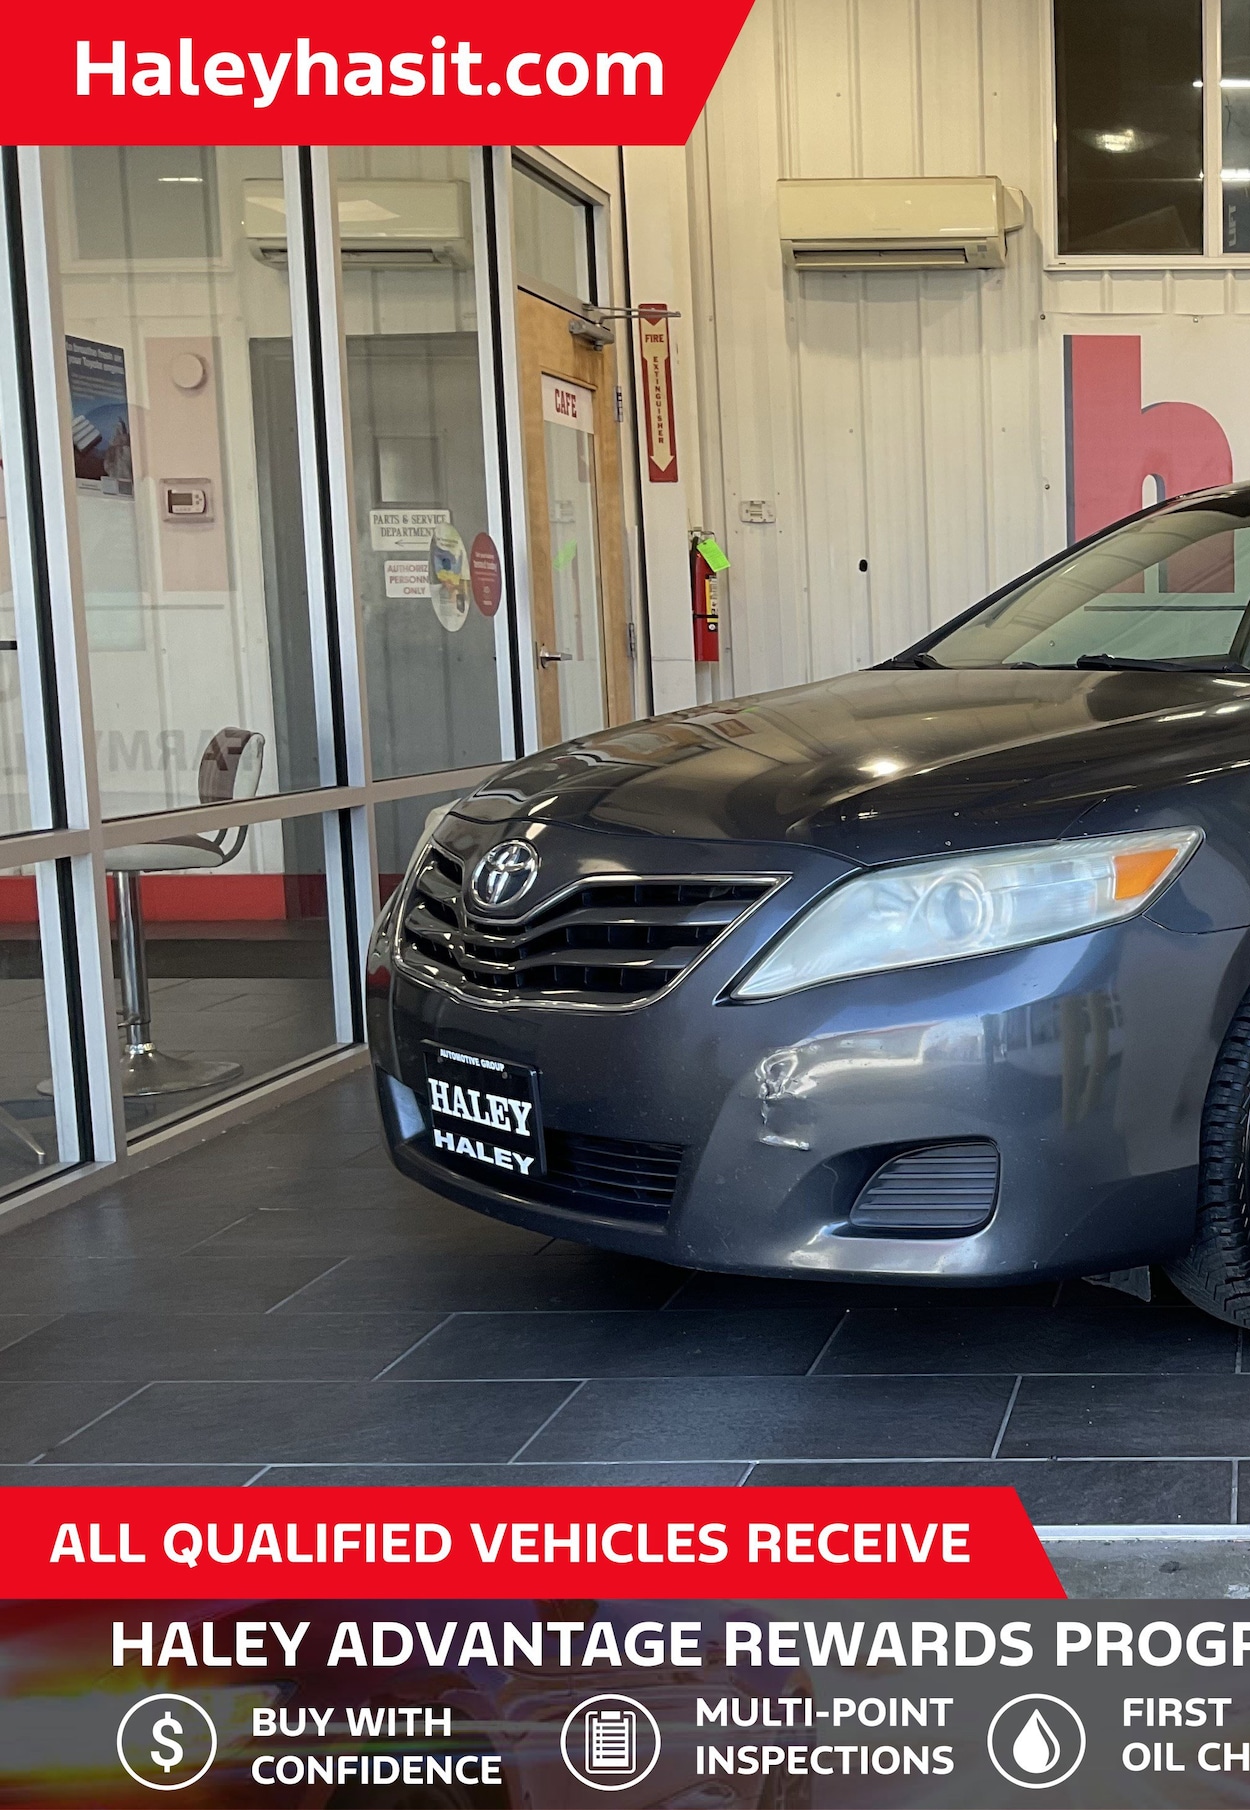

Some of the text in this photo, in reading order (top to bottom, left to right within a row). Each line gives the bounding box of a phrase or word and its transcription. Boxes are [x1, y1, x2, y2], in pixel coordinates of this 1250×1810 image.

[645, 333, 665, 343] FIRE
[554, 388, 578, 419] CAFE
[653, 356, 664, 444] EXTINGUISHER
[373, 514, 446, 525] PARTS & SERVICE
[380, 527, 436, 537] DEPARTMENT
[387, 564, 429, 573] AUTHORIZ
[389, 575, 429, 584] PERSONN
[403, 586, 426, 595] ONLY
[440, 1048, 505, 1072] AUTOMOTIVE GROUP
[428, 1077, 532, 1137] HALEY
[434, 1128, 534, 1175] HALEY
